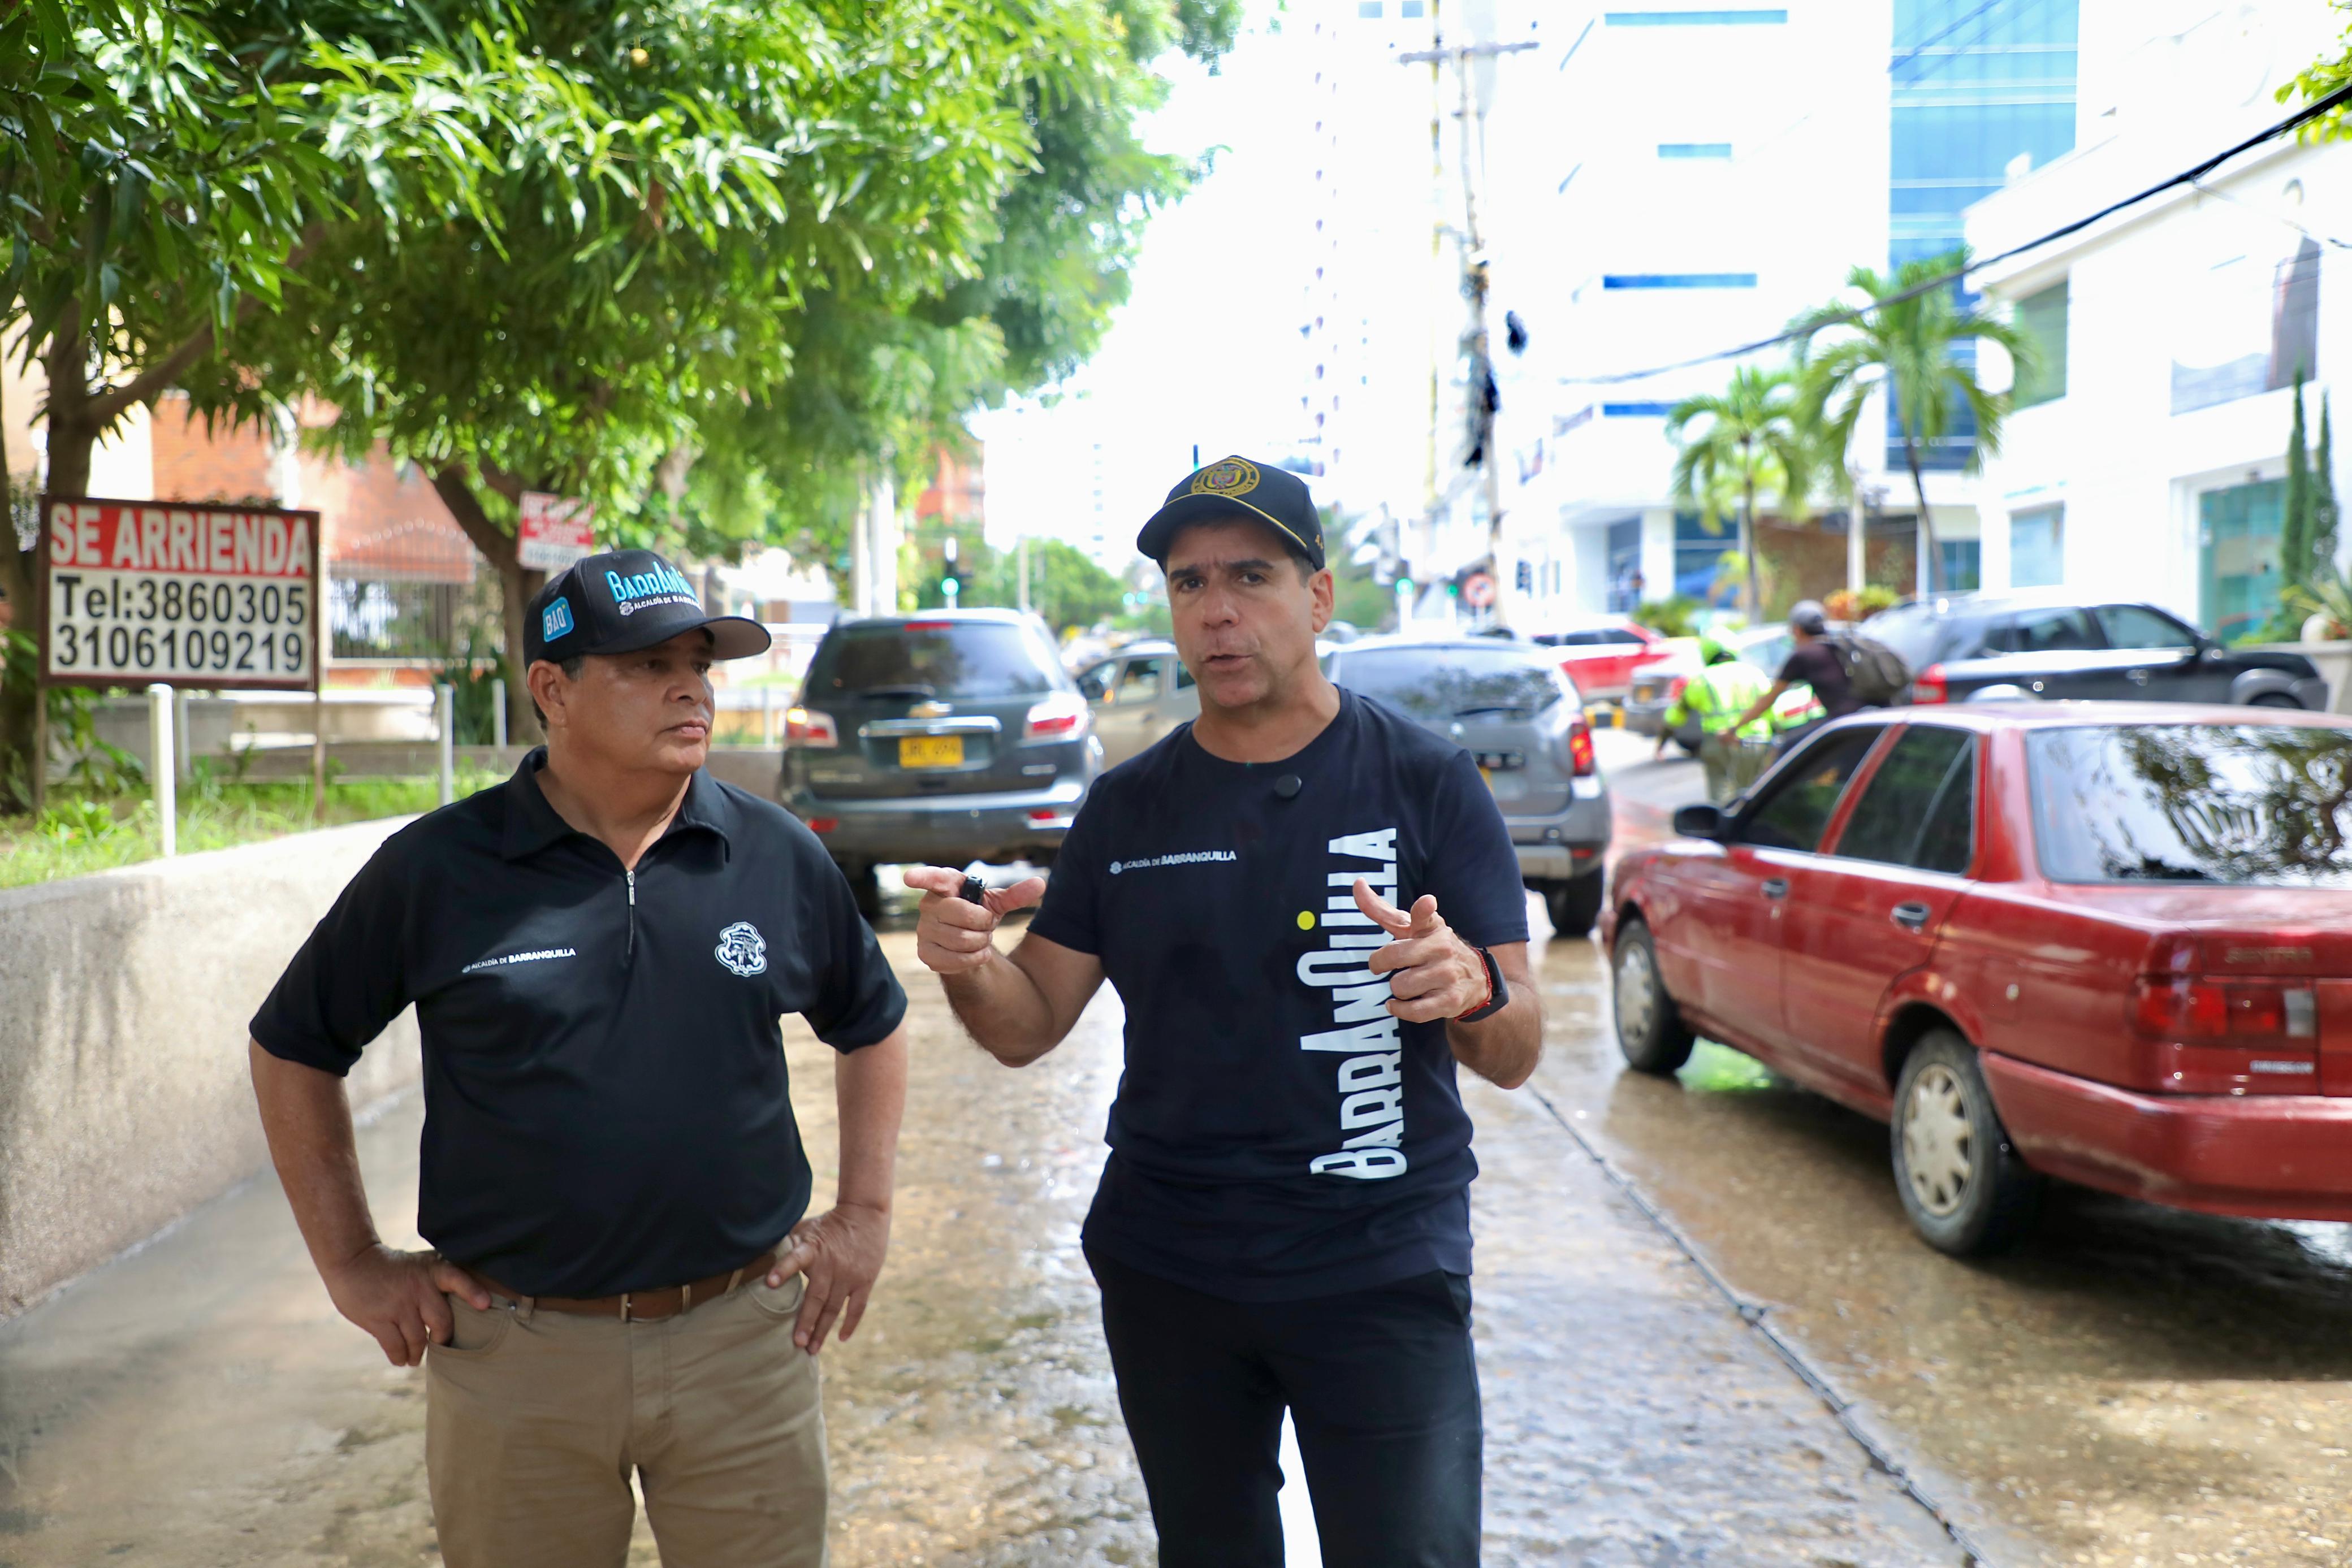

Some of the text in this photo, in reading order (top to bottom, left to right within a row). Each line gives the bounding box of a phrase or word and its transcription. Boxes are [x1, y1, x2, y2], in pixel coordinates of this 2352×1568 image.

[50, 503, 311, 574] SE ARRIENDA
[57, 575, 304, 625] Tel:3860305
[58, 625, 302, 672] 3106109219
[1161, 850, 1237, 865] BARRANQUILLA
[508, 947, 576, 964] BARRANQUILLA
